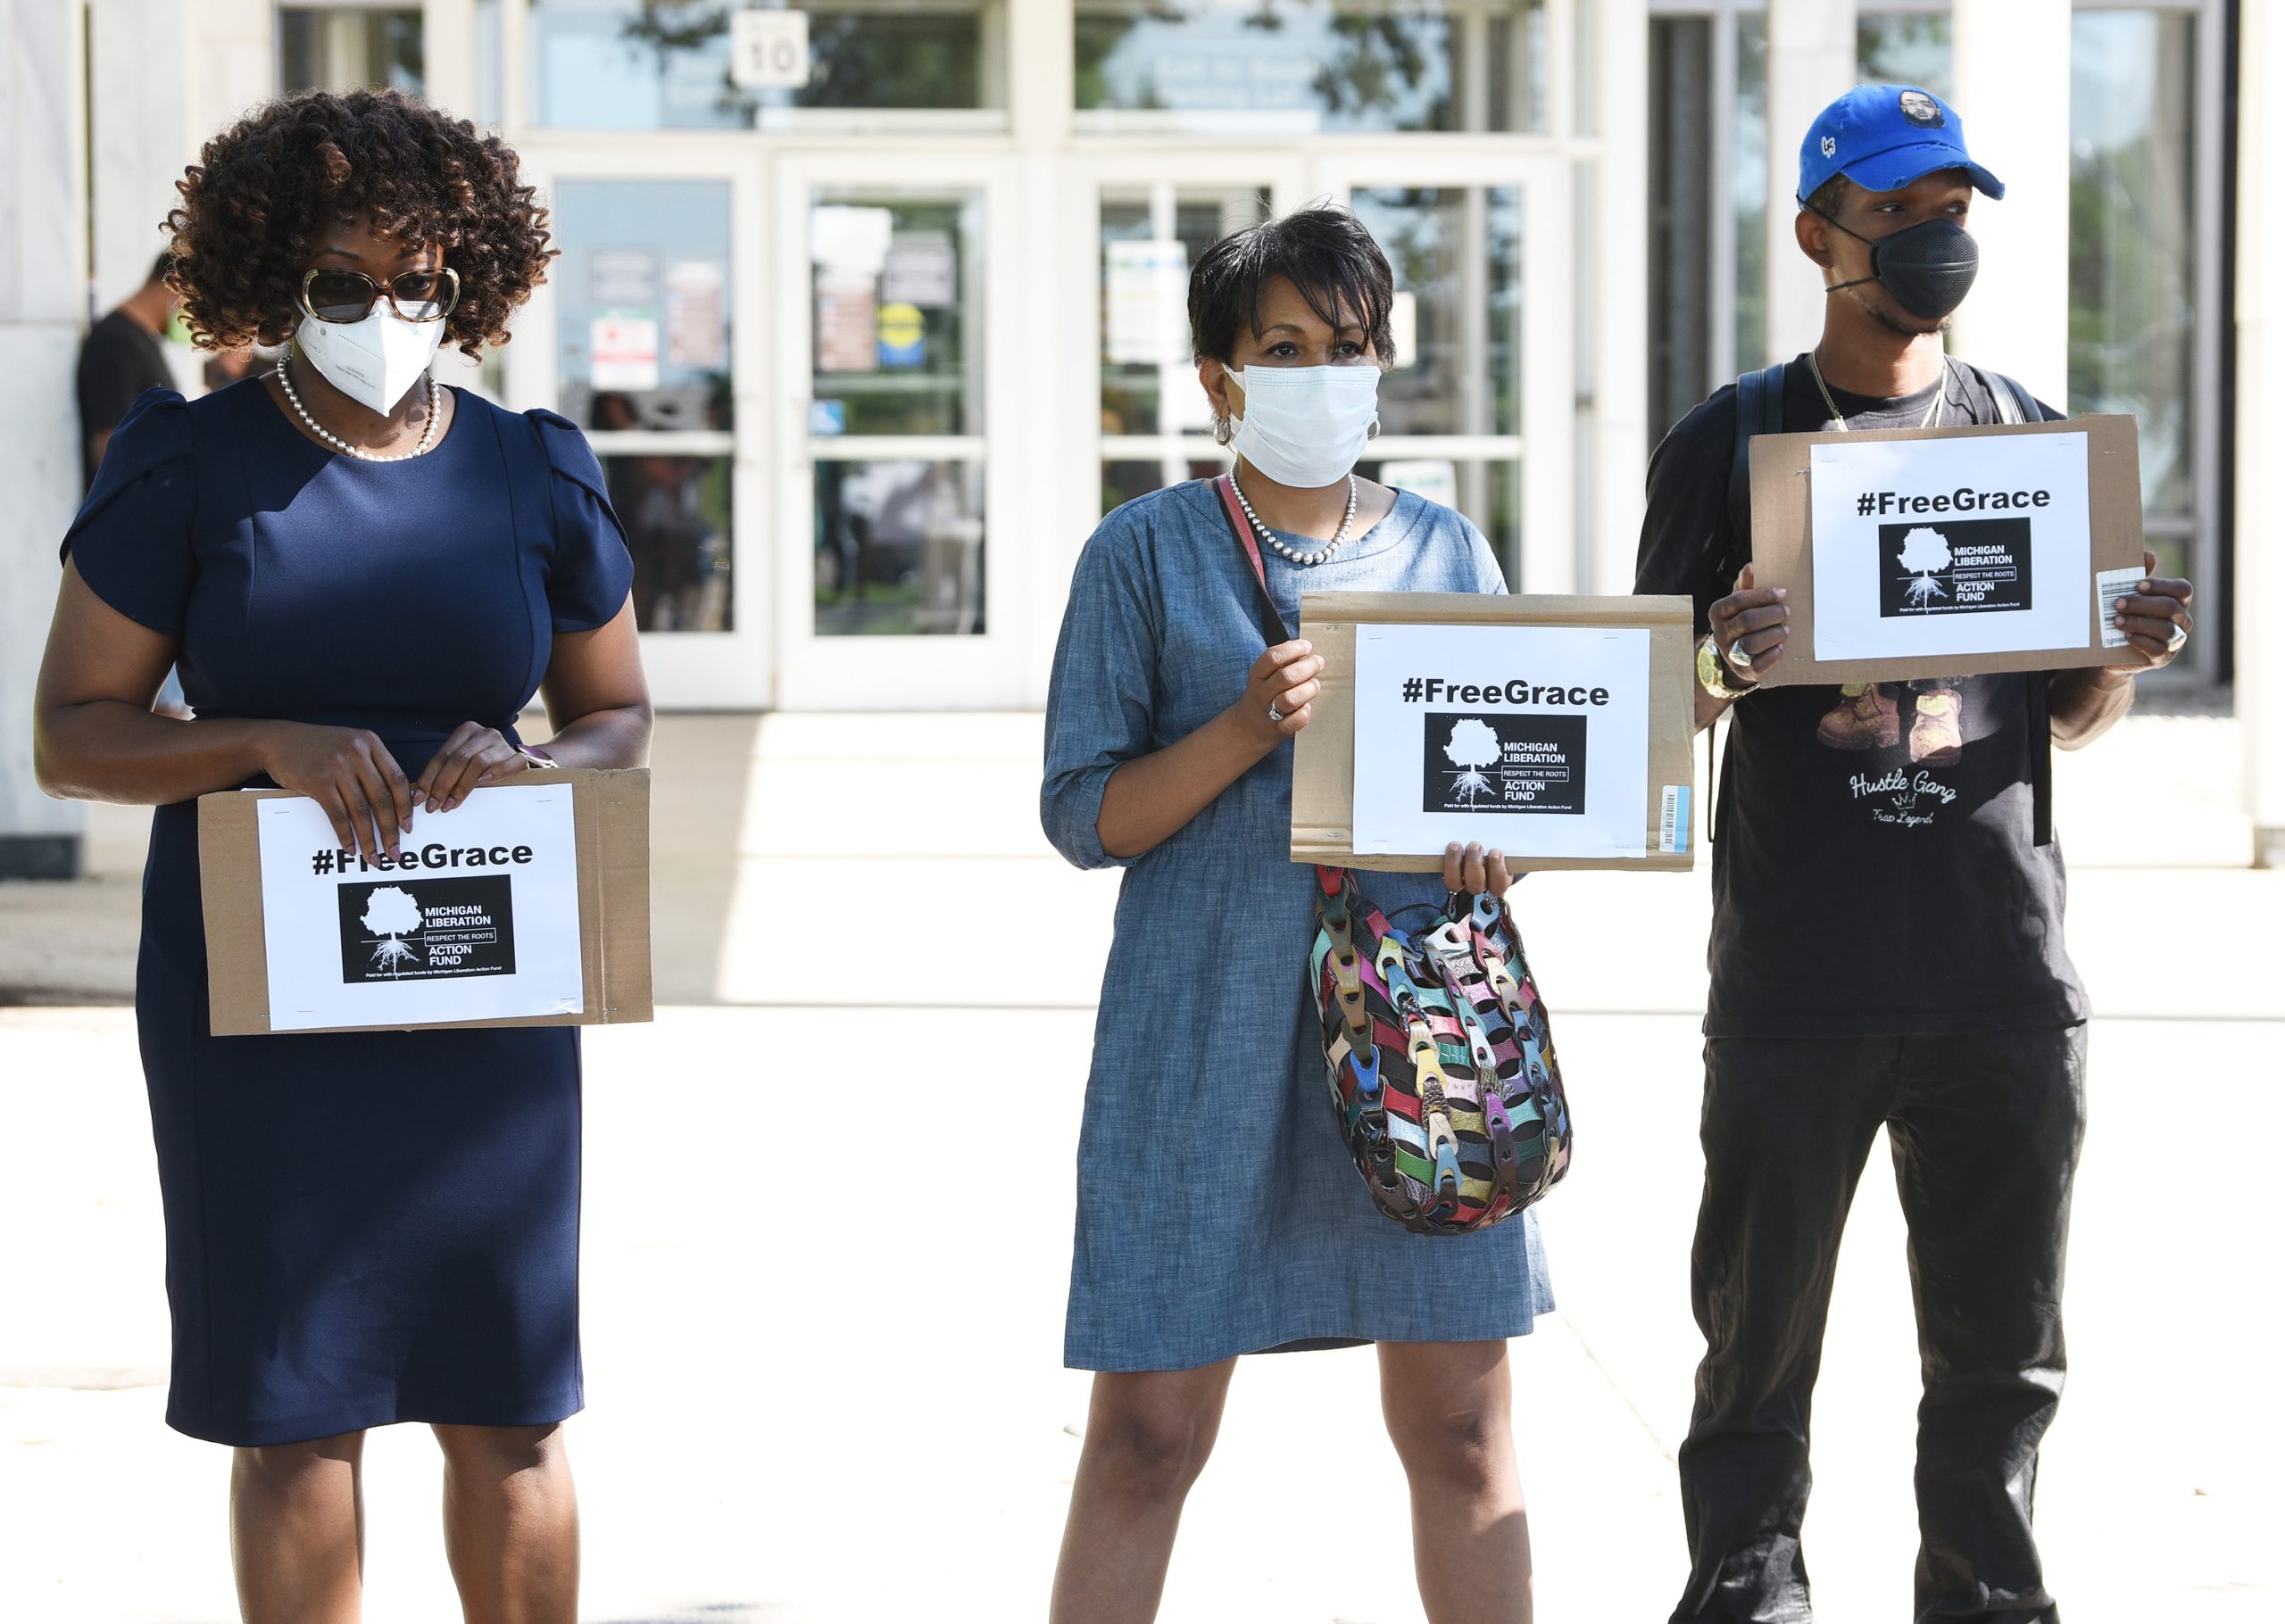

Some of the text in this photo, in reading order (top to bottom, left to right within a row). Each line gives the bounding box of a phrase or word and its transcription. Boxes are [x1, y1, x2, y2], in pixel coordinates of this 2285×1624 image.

[750, 38, 798, 73] 10
[1857, 487, 2051, 517] #FreeGrace
[1954, 544, 2005, 557] MICHIGAN
[1954, 554, 2013, 567] LIBERATION
[1955, 572, 1981, 580] RESPECT
[1956, 582, 1995, 592] ACTION
[1957, 592, 1985, 602] FUND
[1402, 677, 1610, 706] #FreeGrace
[1503, 742, 1558, 752] MICHIGAN
[1503, 752, 1566, 764] LIBERATION
[1545, 770, 1567, 778] ROOTS
[1504, 781, 1546, 791] ACTION
[1849, 767, 1957, 804] Hustle Gang
[1504, 791, 1535, 801] FUND
[1896, 810, 1934, 828] Legend
[425, 905, 482, 917] MICHIGAN
[426, 915, 492, 928] LIBERATION
[427, 934, 456, 942] RESPECT
[428, 944, 472, 957] ACTION
[429, 955, 461, 966] FUND
